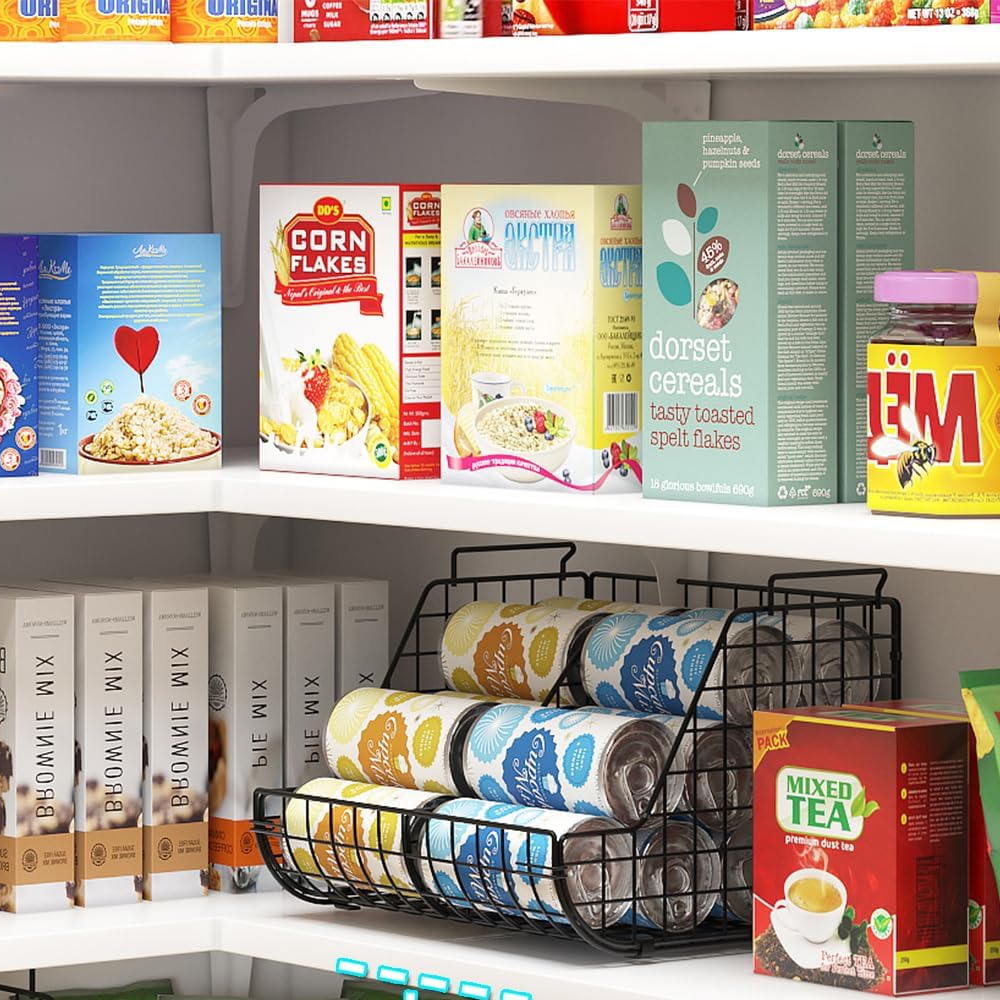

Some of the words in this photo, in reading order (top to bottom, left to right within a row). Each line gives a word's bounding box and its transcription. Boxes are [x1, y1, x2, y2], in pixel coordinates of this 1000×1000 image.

[702, 133, 742, 145] pineapple,
[702, 145, 741, 156] hazelnuts
[777, 149, 801, 159] dorset
[802, 149, 829, 159] cereals
[855, 149, 880, 159] dorset
[881, 149, 907, 159] cereals
[702, 158, 738, 170] pumpkin
[739, 158, 760, 168] seeds
[290, 229, 367, 252] CORN
[290, 255, 367, 275] FLAKES
[308, 284, 336, 298] Original
[353, 282, 371, 294] Best
[649, 330, 733, 363] dorset
[649, 367, 742, 398] cereals
[650, 402, 691, 424] tasty
[693, 403, 755, 426] toasted
[650, 429, 689, 450] spelt
[693, 429, 741, 451] flakes
[660, 479, 695, 492] glorious
[696, 480, 731, 494] bowlfuls
[732, 482, 755, 498] 690g
[757, 731, 789, 749] PACK
[786, 774, 852, 800] MIXED
[786, 794, 851, 832] TEA
[785, 834, 820, 848] premium
[820, 837, 839, 850] dust
[840, 841, 854, 852] tea
